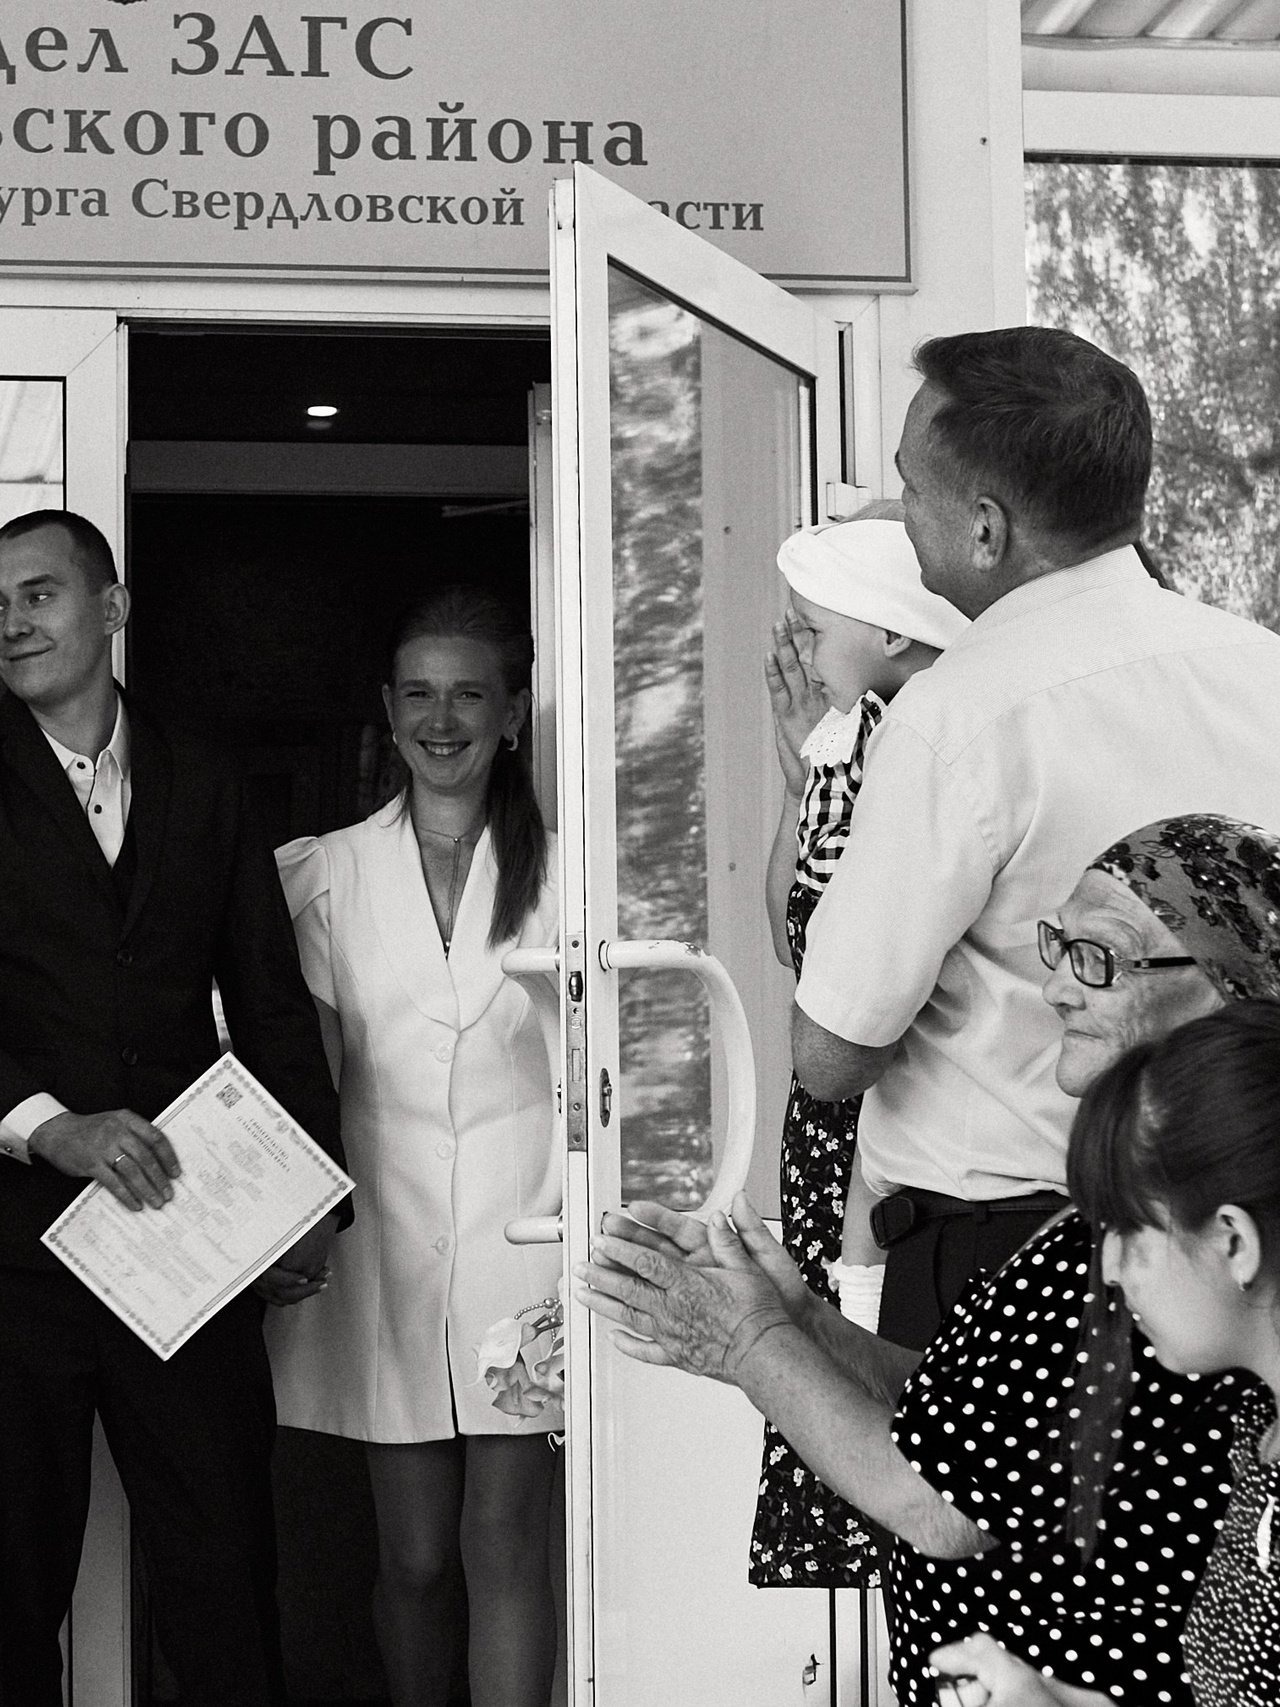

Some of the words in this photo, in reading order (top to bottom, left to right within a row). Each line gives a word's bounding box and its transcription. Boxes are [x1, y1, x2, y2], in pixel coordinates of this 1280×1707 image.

[170, 12, 415, 80] ЗАГС
[312, 101, 650, 176] района
[131, 178, 526, 231] Свердловской
